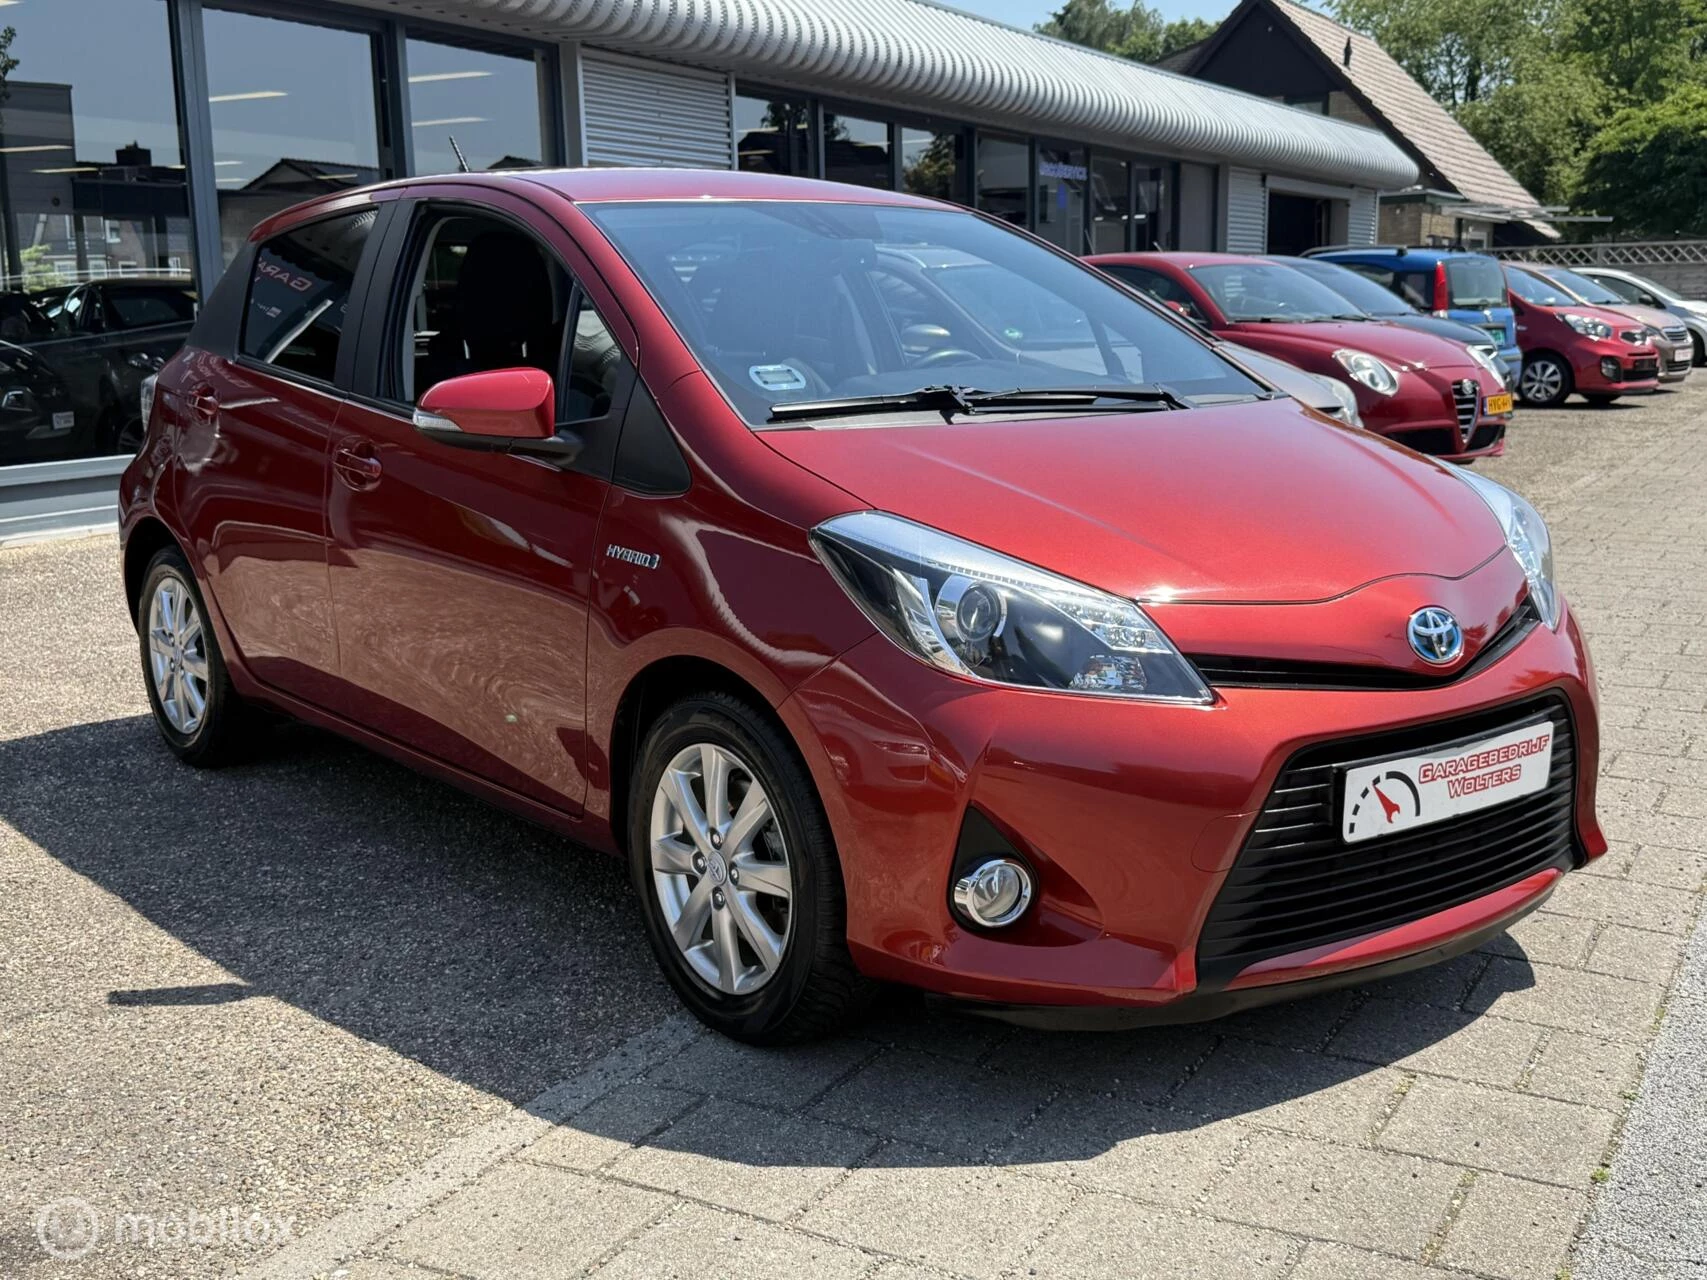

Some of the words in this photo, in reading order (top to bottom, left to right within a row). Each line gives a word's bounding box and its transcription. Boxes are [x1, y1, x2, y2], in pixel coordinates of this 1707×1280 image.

[606, 544, 651, 567] HYBRID
[1418, 735, 1549, 784] GARAGEBEDRIJF
[1447, 765, 1521, 798] WOLTERS
